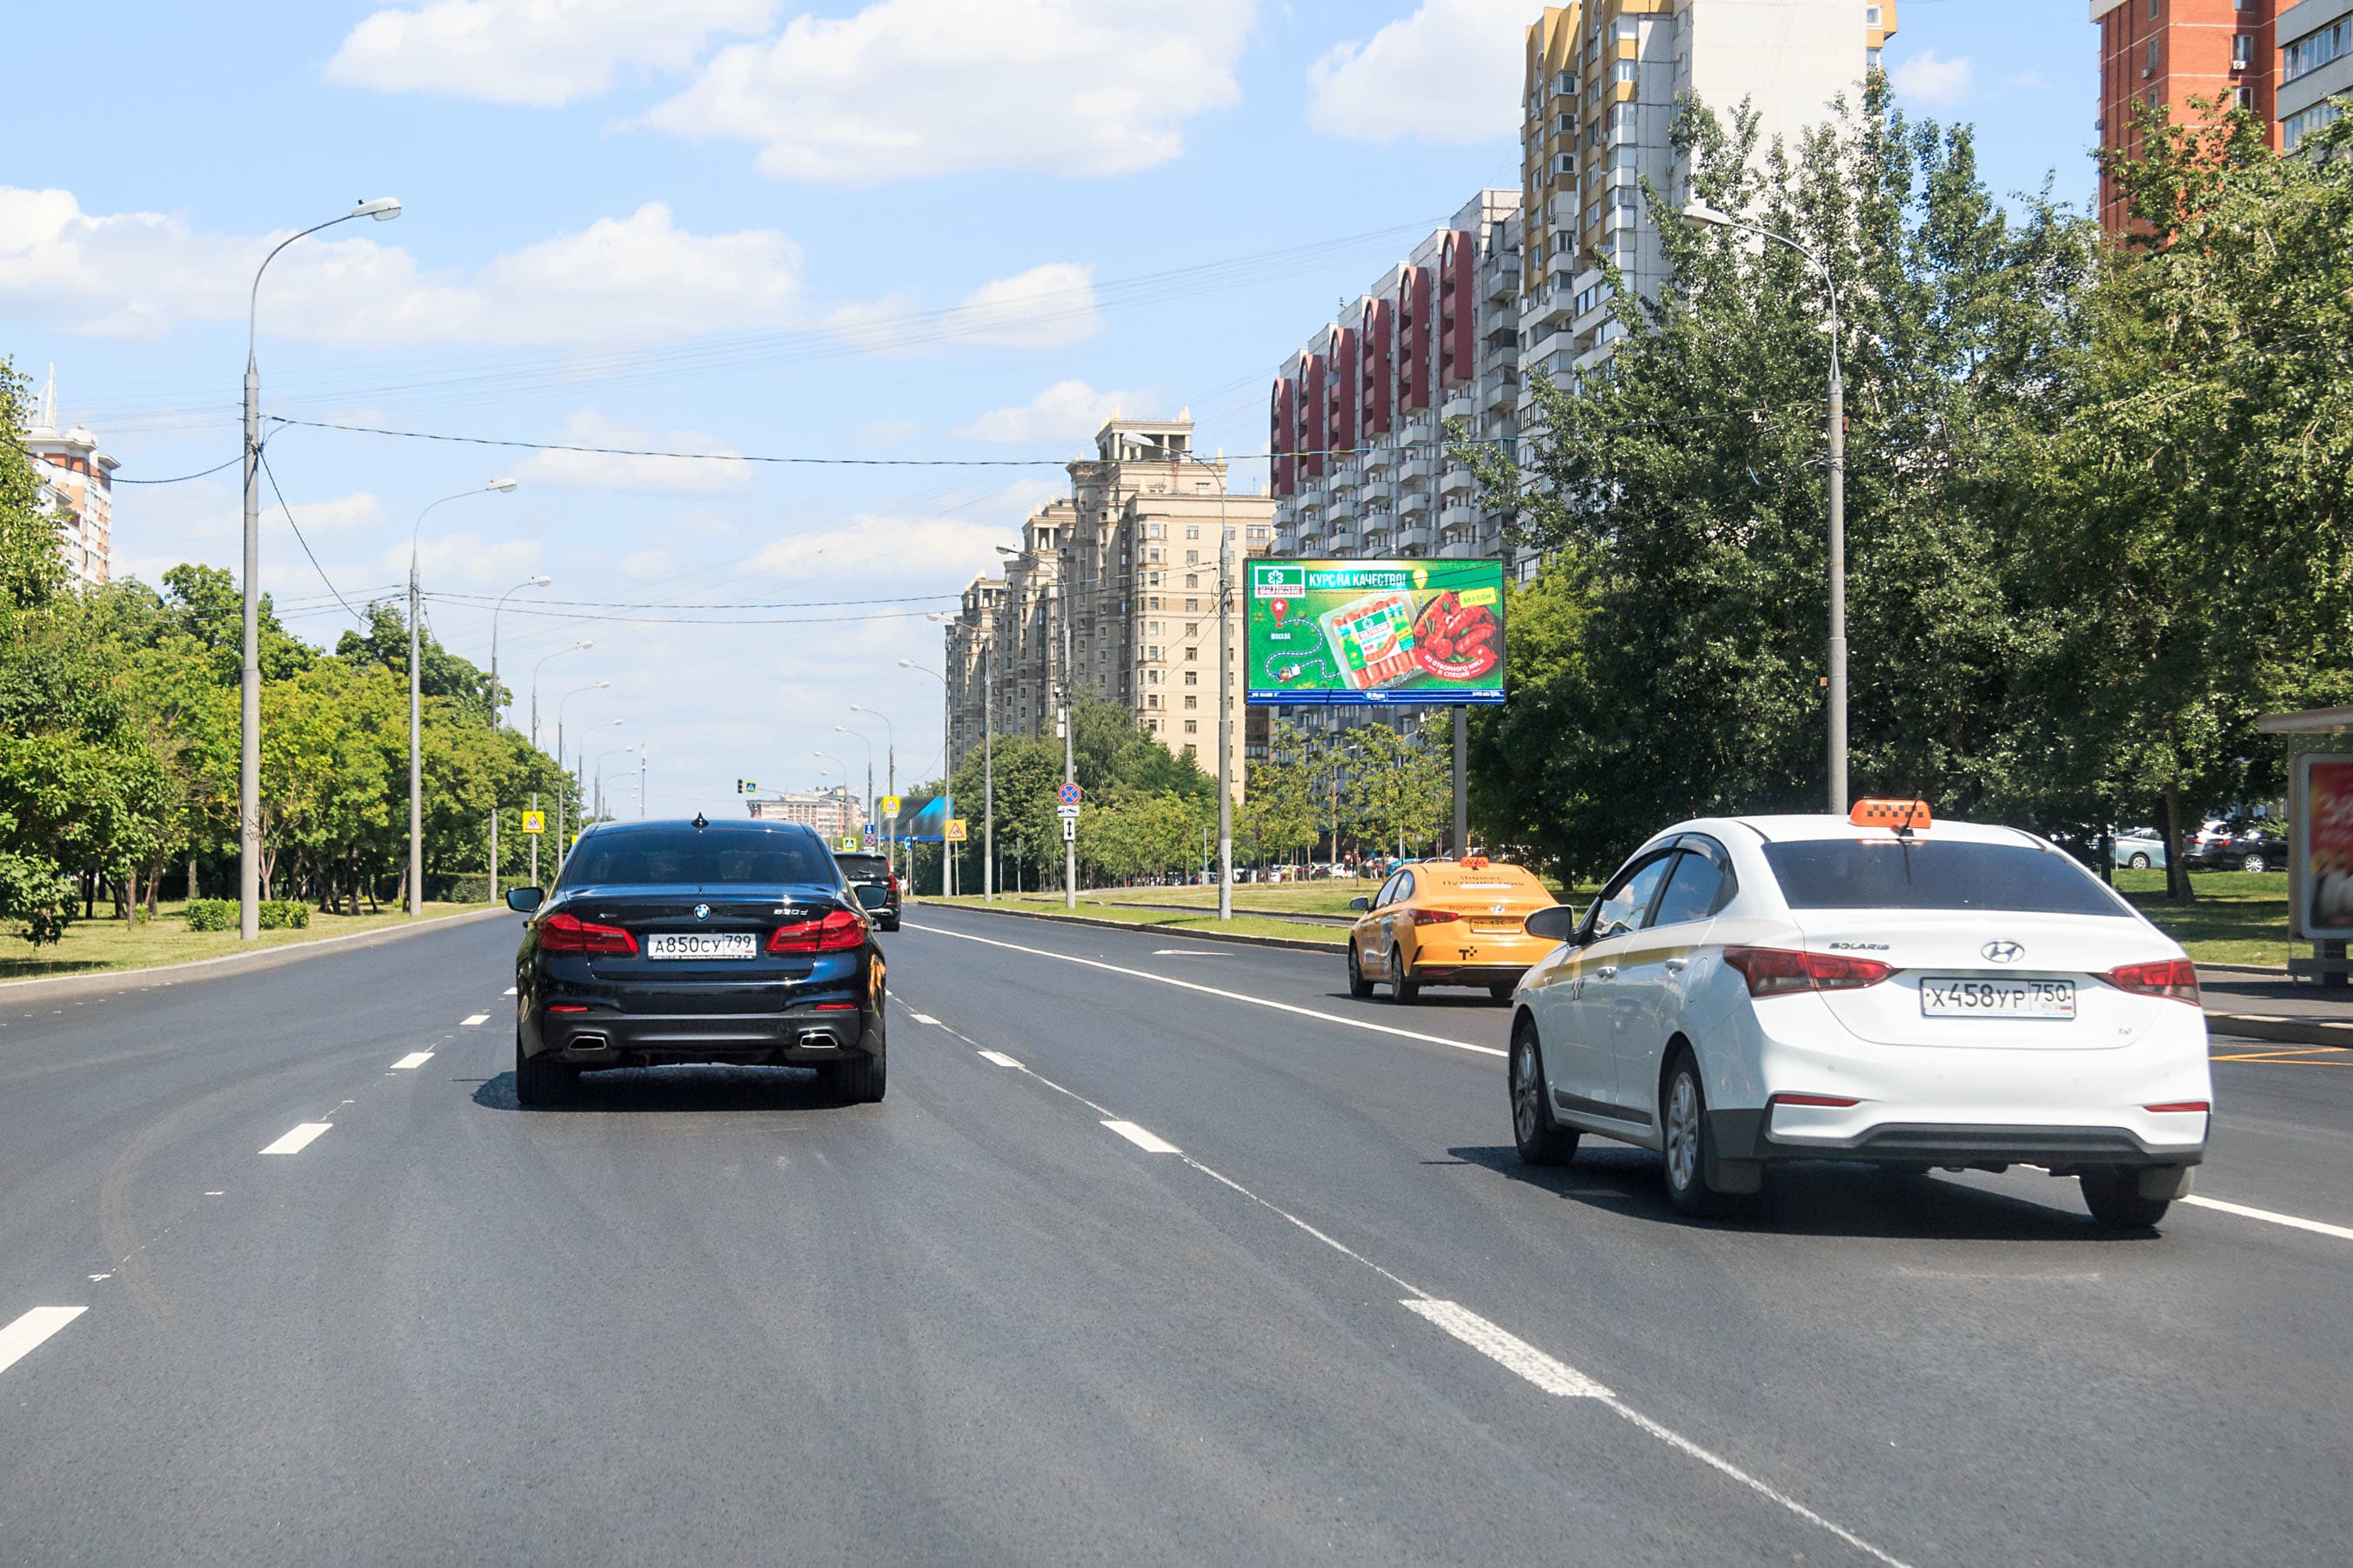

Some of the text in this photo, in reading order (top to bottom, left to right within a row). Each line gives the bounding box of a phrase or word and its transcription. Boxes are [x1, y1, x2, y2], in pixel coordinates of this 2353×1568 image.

[1309, 573, 1406, 586] КУРС НА КАЧЕСТВО!
[655, 937, 721, 953] А850СУ
[725, 935, 752, 948] 799
[1932, 983, 2068, 1008] Х458УР 750
